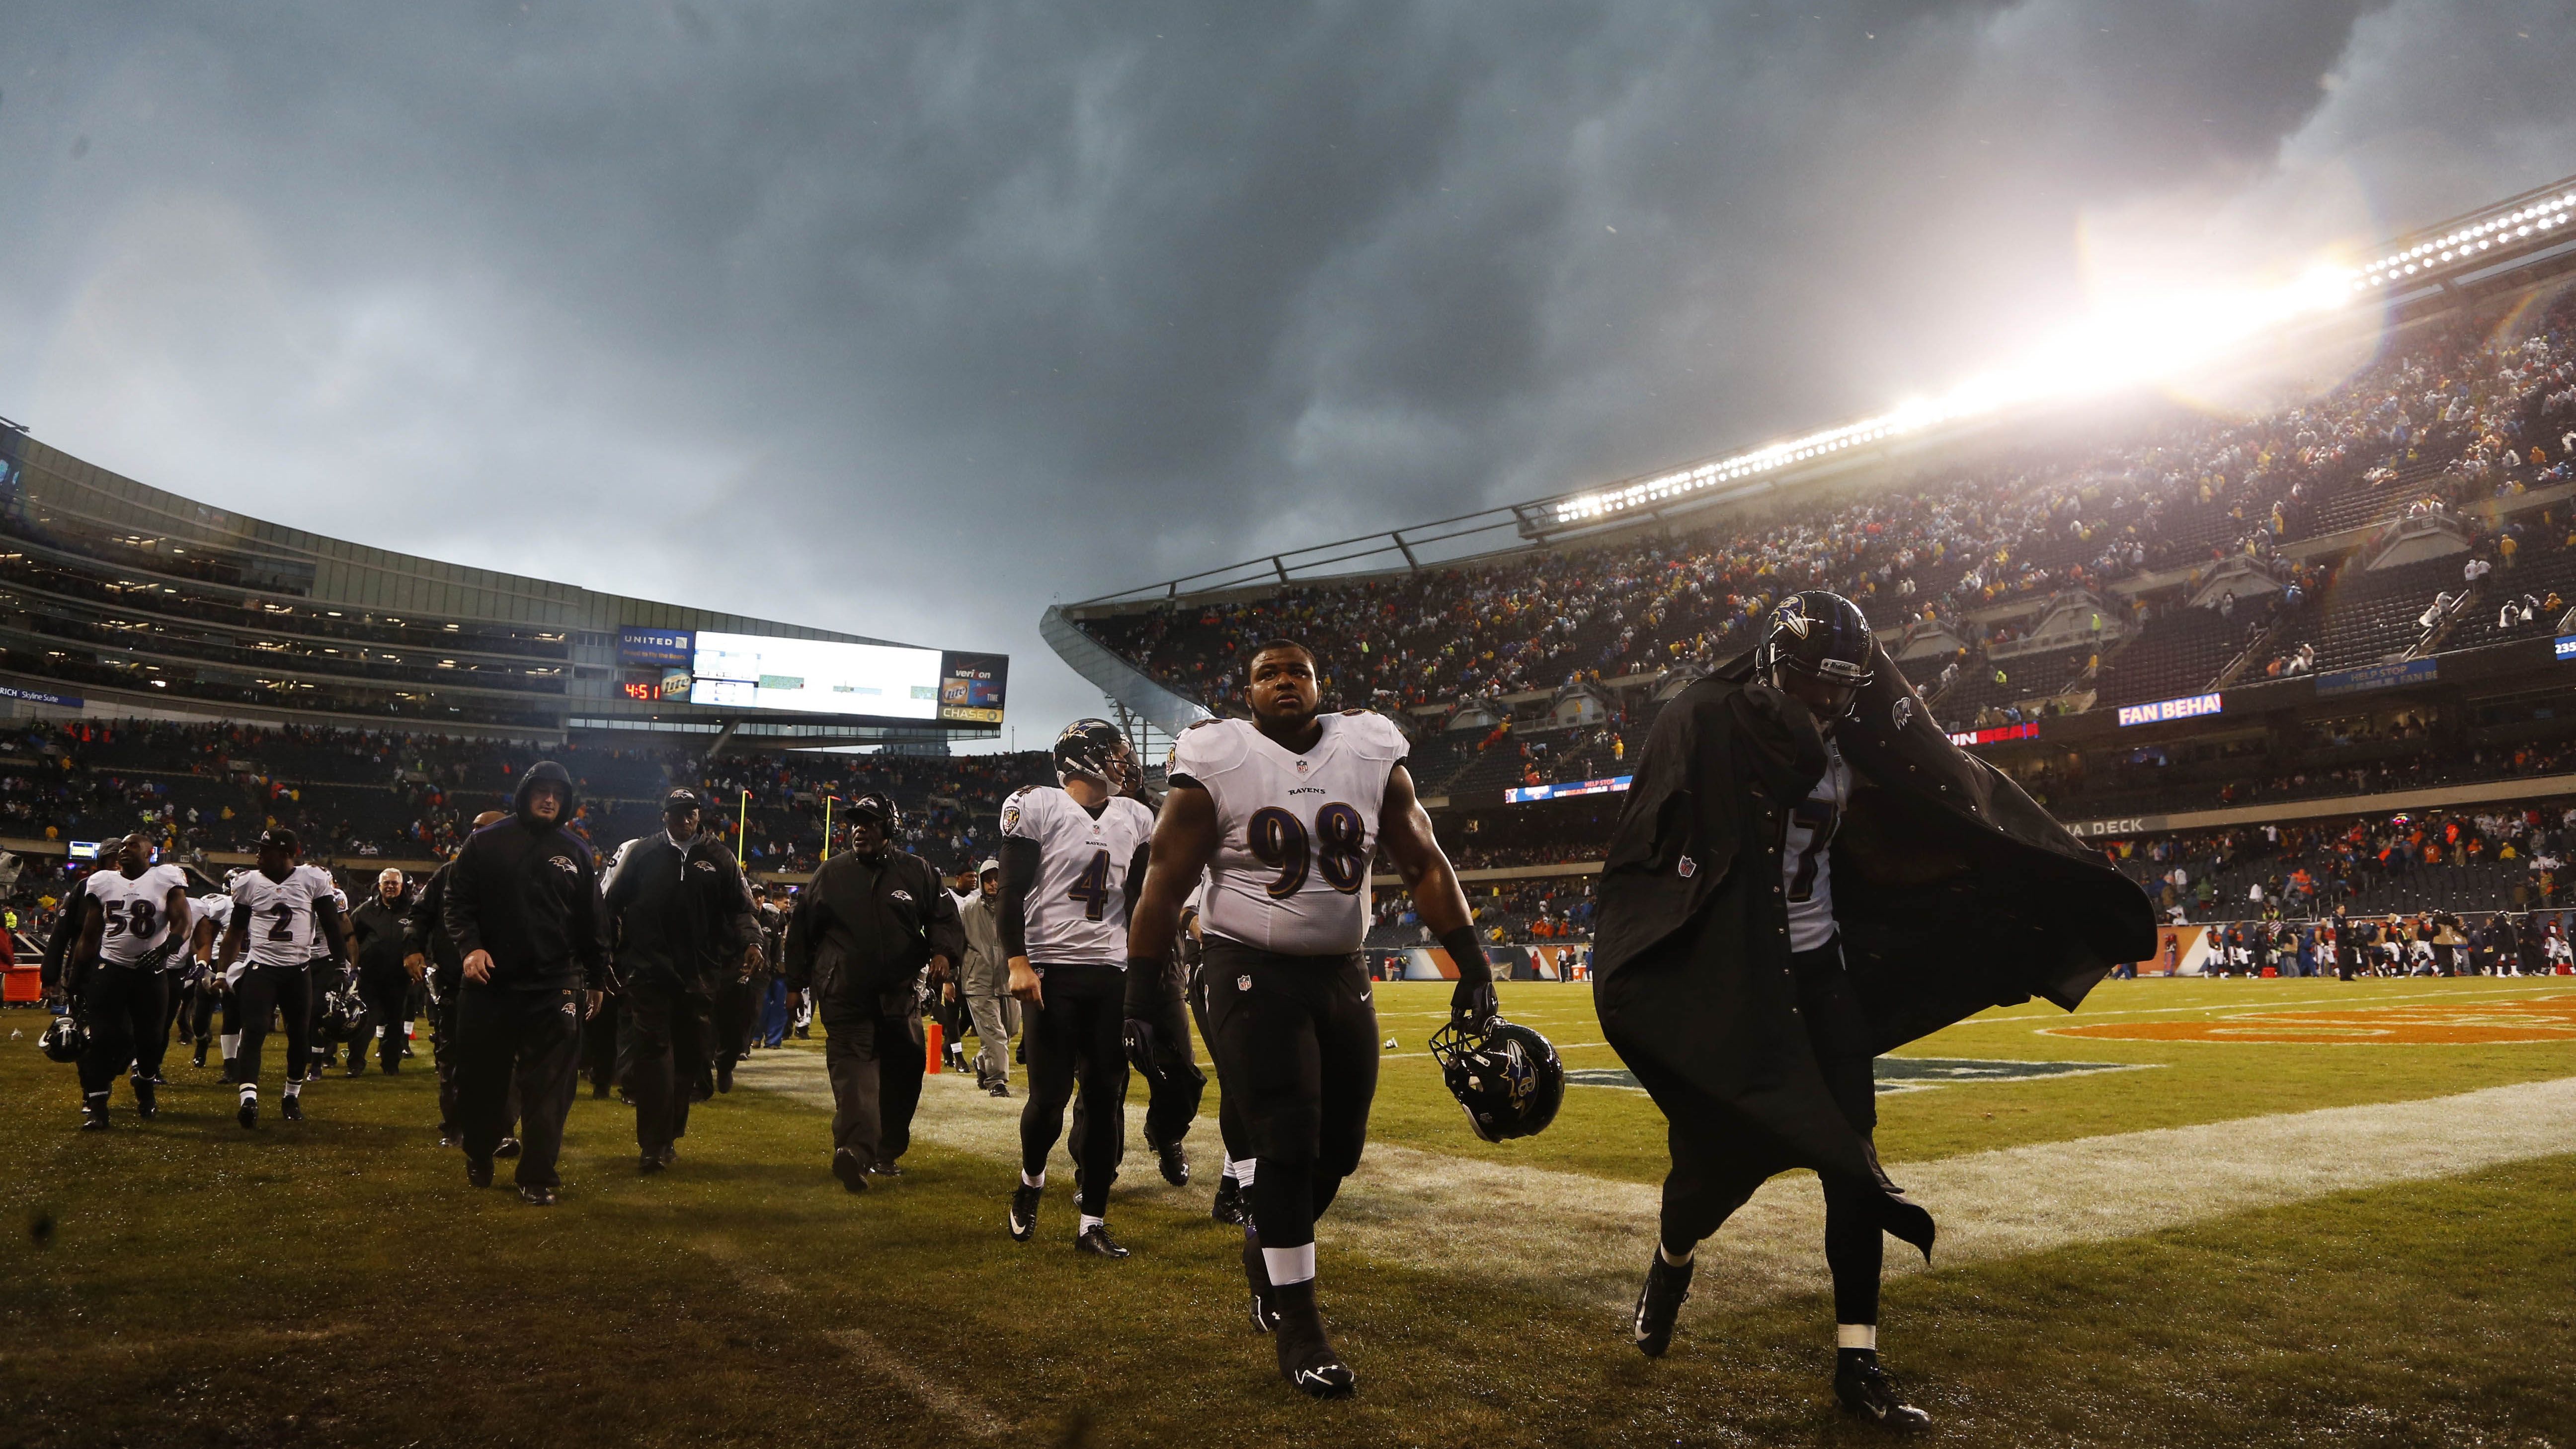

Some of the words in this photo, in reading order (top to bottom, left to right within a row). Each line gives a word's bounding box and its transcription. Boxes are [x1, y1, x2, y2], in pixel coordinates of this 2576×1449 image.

[625, 636, 673, 645] UNITED
[2351, 671, 2378, 682] HELP
[2380, 666, 2408, 677] STOP
[21, 691, 43, 701] Skyline
[43, 694, 59, 703] Suite
[625, 683, 660, 700] 4:51
[943, 708, 983, 719] CHASE
[2119, 705, 2159, 725] FAN
[2093, 819, 2144, 835] DECK
[1247, 802, 1366, 900] 98
[1786, 797, 1838, 903] 7
[1068, 849, 1111, 921] 4
[105, 899, 156, 939] 58
[268, 902, 294, 942] 2
